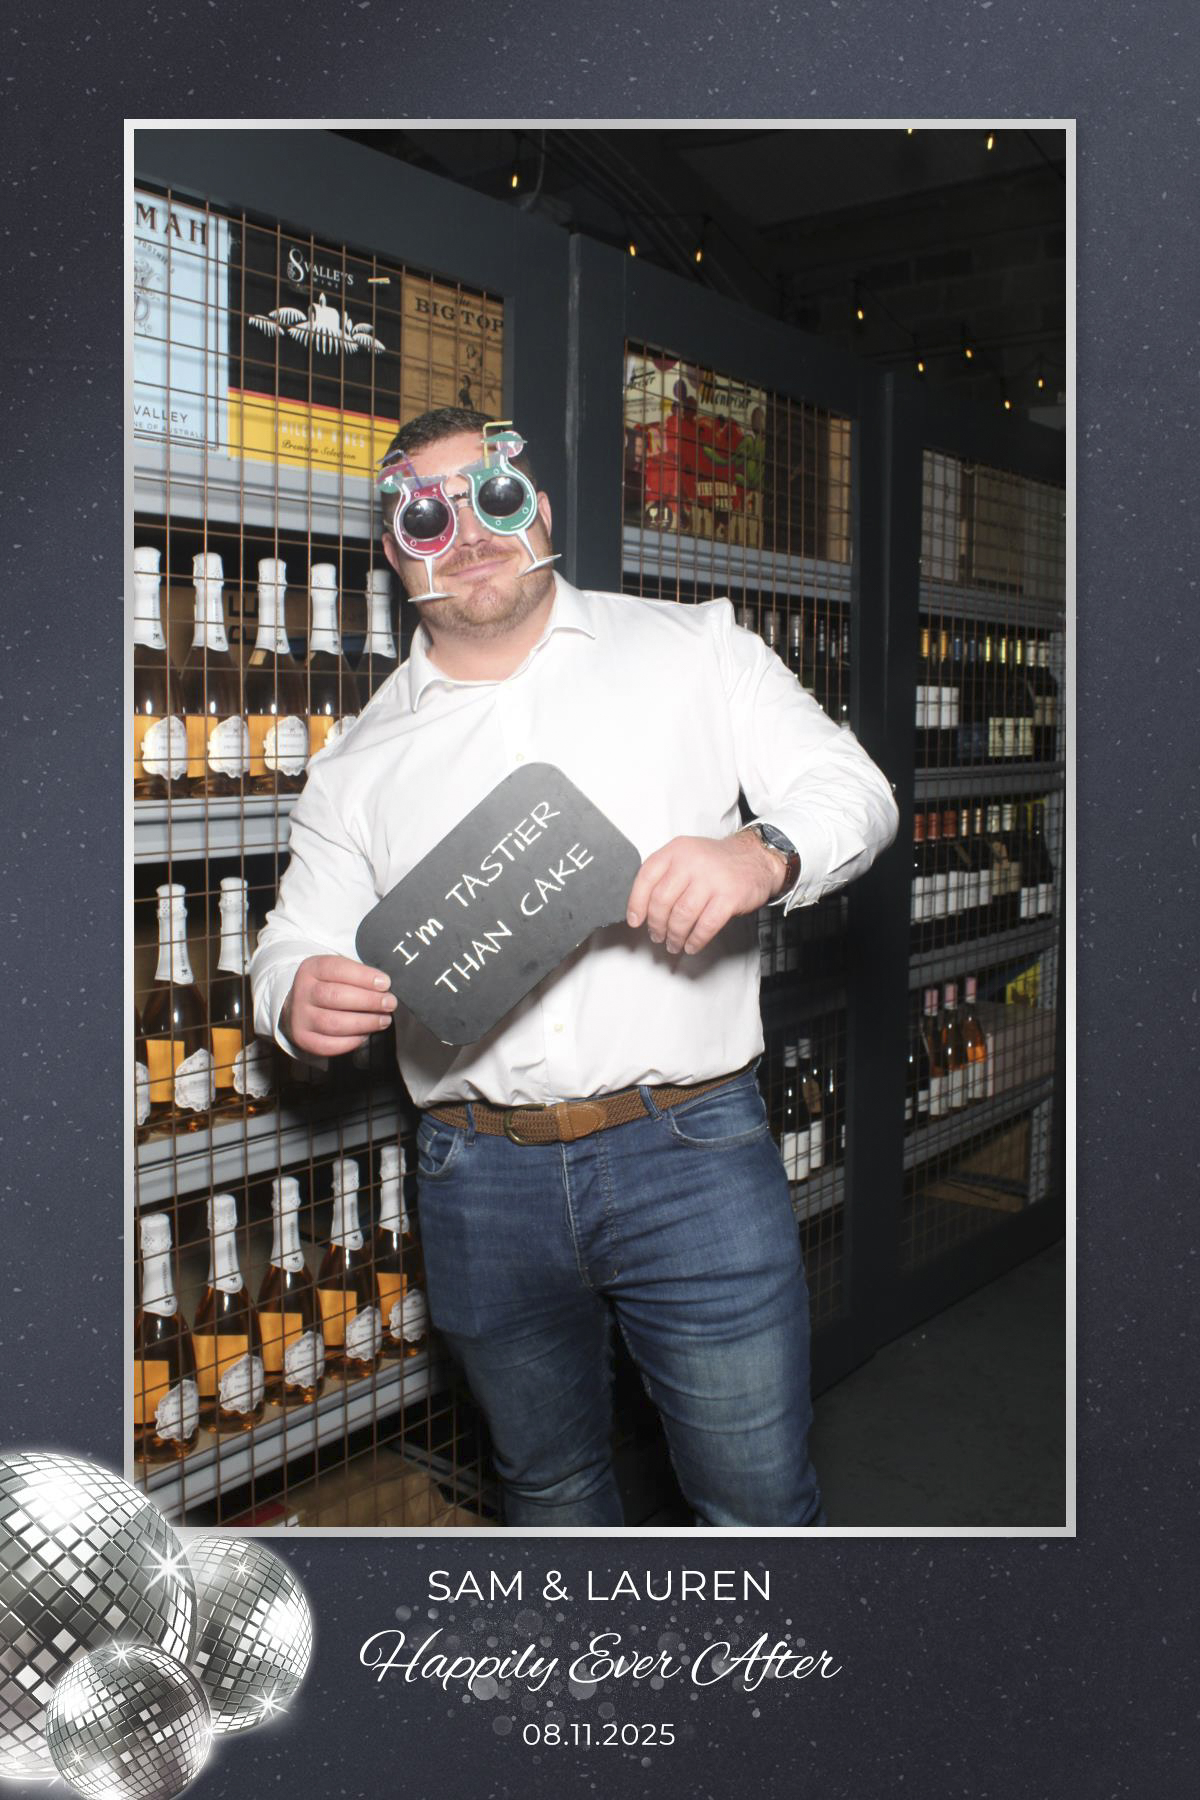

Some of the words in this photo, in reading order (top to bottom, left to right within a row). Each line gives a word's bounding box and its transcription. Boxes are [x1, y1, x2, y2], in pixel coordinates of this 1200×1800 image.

[415, 296, 456, 321] BIG
[460, 310, 504, 332] TOP
[434, 920, 513, 993] THAN
[519, 842, 594, 916] CAKE
